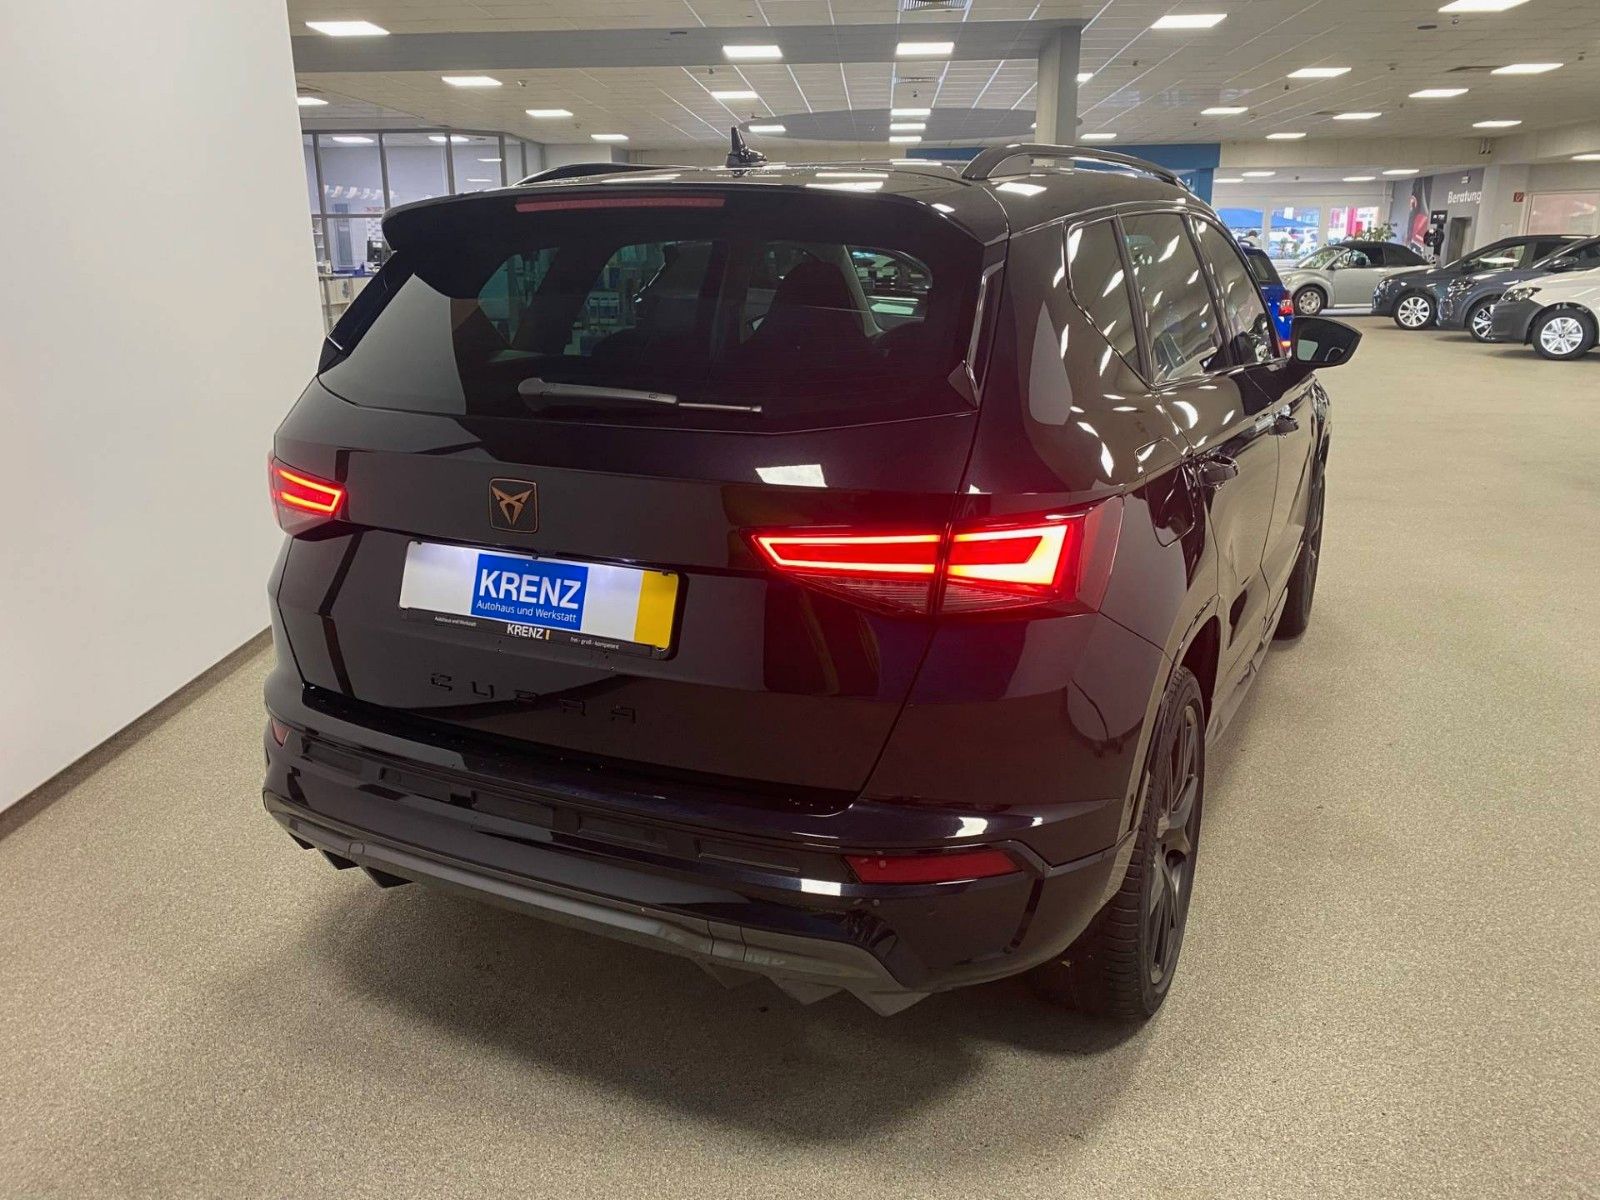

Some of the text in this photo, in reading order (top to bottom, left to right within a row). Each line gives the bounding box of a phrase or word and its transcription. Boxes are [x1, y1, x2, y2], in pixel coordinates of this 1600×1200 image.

[1447, 190, 1482, 204] Beratung
[478, 568, 582, 610] KRENZ
[476, 600, 577, 623] Autohaus und Werkstatt
[507, 623, 544, 639] KRENZ
[430, 673, 637, 724] CUPRA
